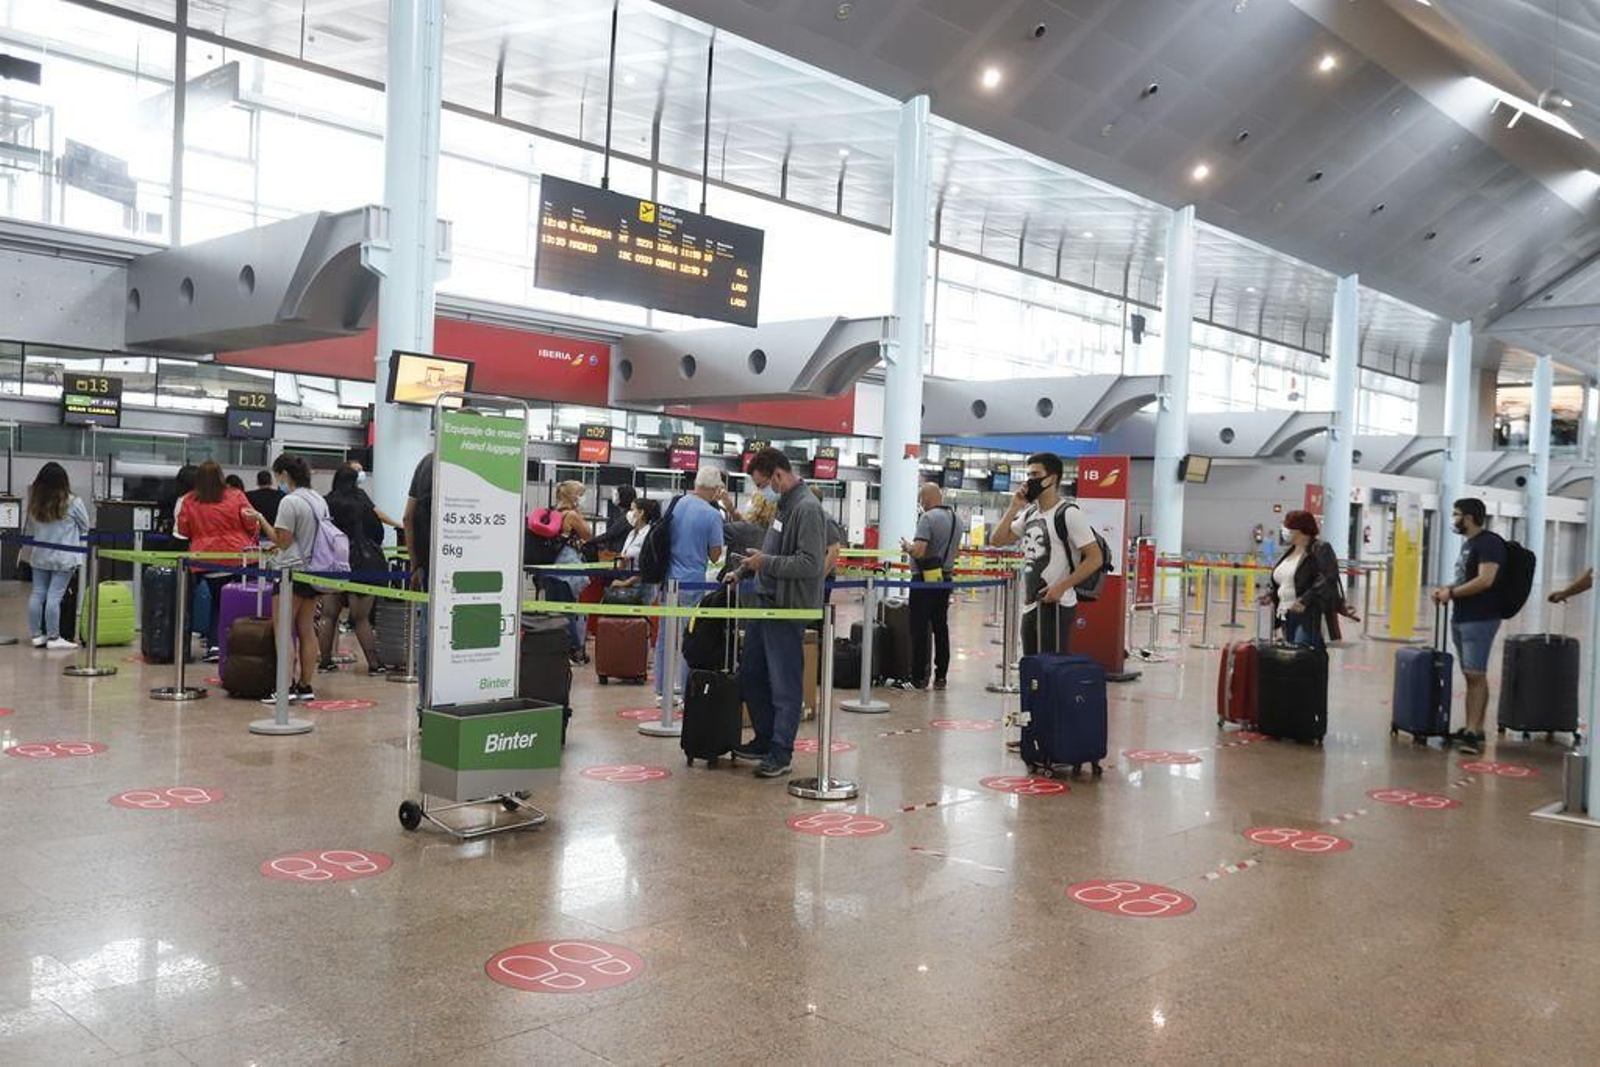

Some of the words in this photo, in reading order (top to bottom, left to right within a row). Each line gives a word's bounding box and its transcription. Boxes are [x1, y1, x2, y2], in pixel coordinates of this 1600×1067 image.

[538, 349, 571, 360] IBERIA
[89, 378, 109, 393] 13
[250, 394, 267, 408] 12
[444, 423, 483, 437] Equipaje
[485, 427, 496, 436] de
[498, 430, 523, 439] mano
[461, 439, 487, 450] Hand
[487, 443, 521, 456] luggage
[443, 513, 457, 524] 45
[459, 516, 466, 524] x
[468, 513, 482, 525] 35
[484, 516, 491, 525] x
[493, 514, 507, 525] 25
[442, 544, 463, 558] 6kg
[479, 678, 512, 690] Binter
[484, 732, 538, 753] Binter
